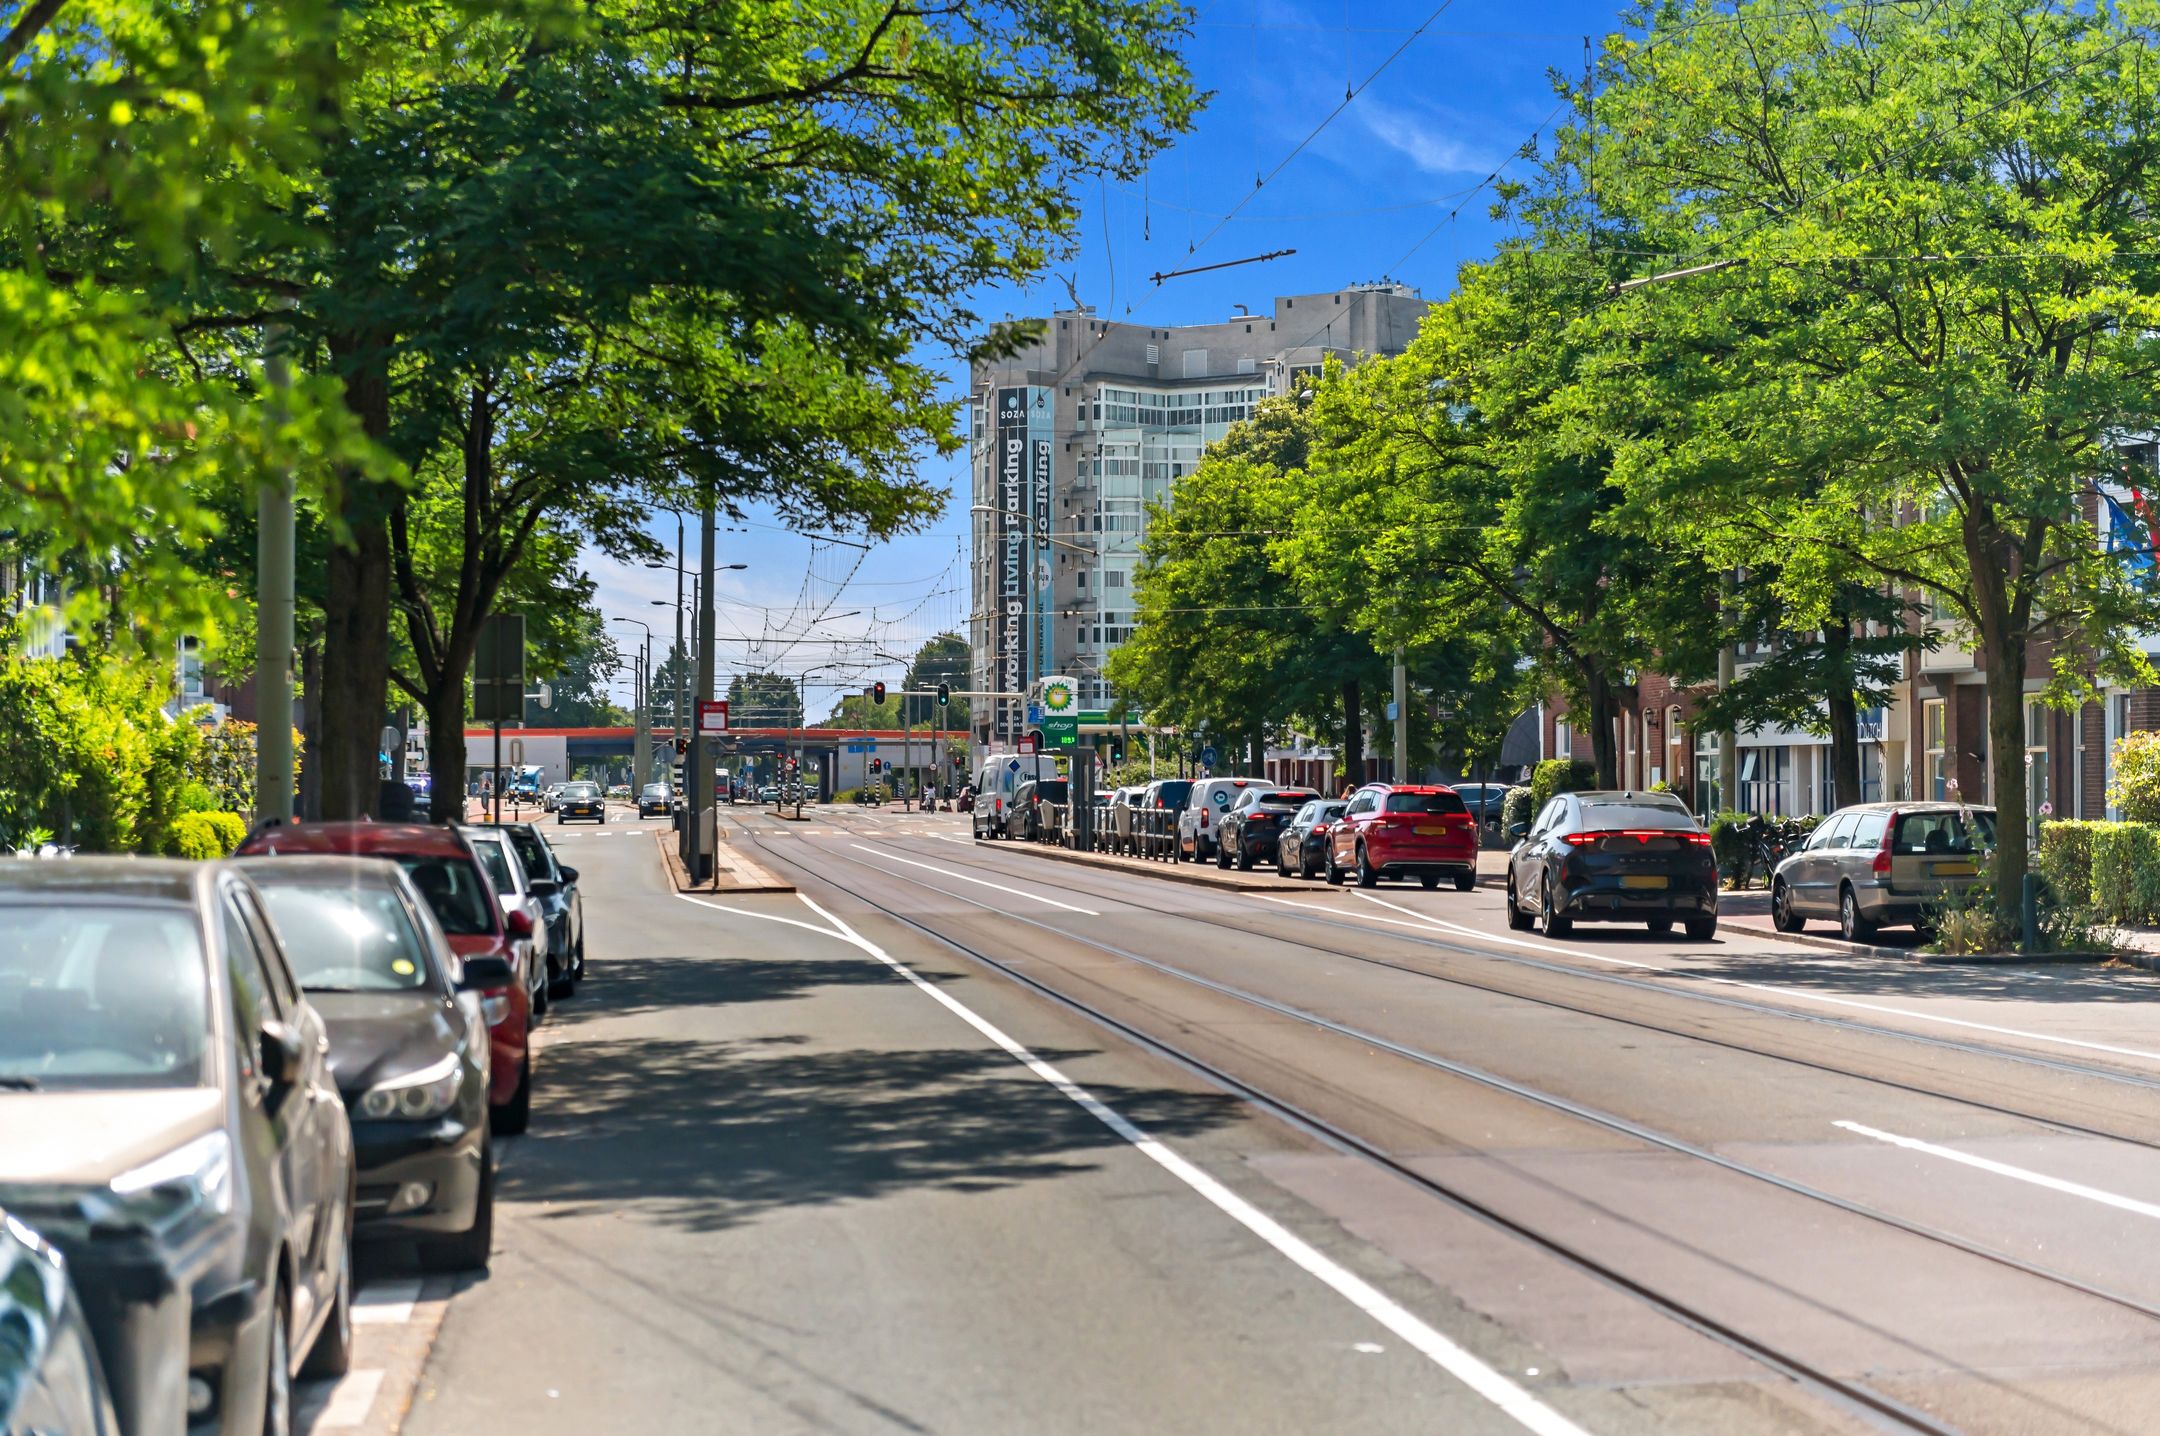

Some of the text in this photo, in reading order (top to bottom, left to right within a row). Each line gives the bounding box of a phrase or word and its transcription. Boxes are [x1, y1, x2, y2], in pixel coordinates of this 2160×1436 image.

[1001, 410, 1025, 419] SOZA
[1004, 439, 1023, 692] Working Living Parking
[1048, 721, 1073, 730] shop
